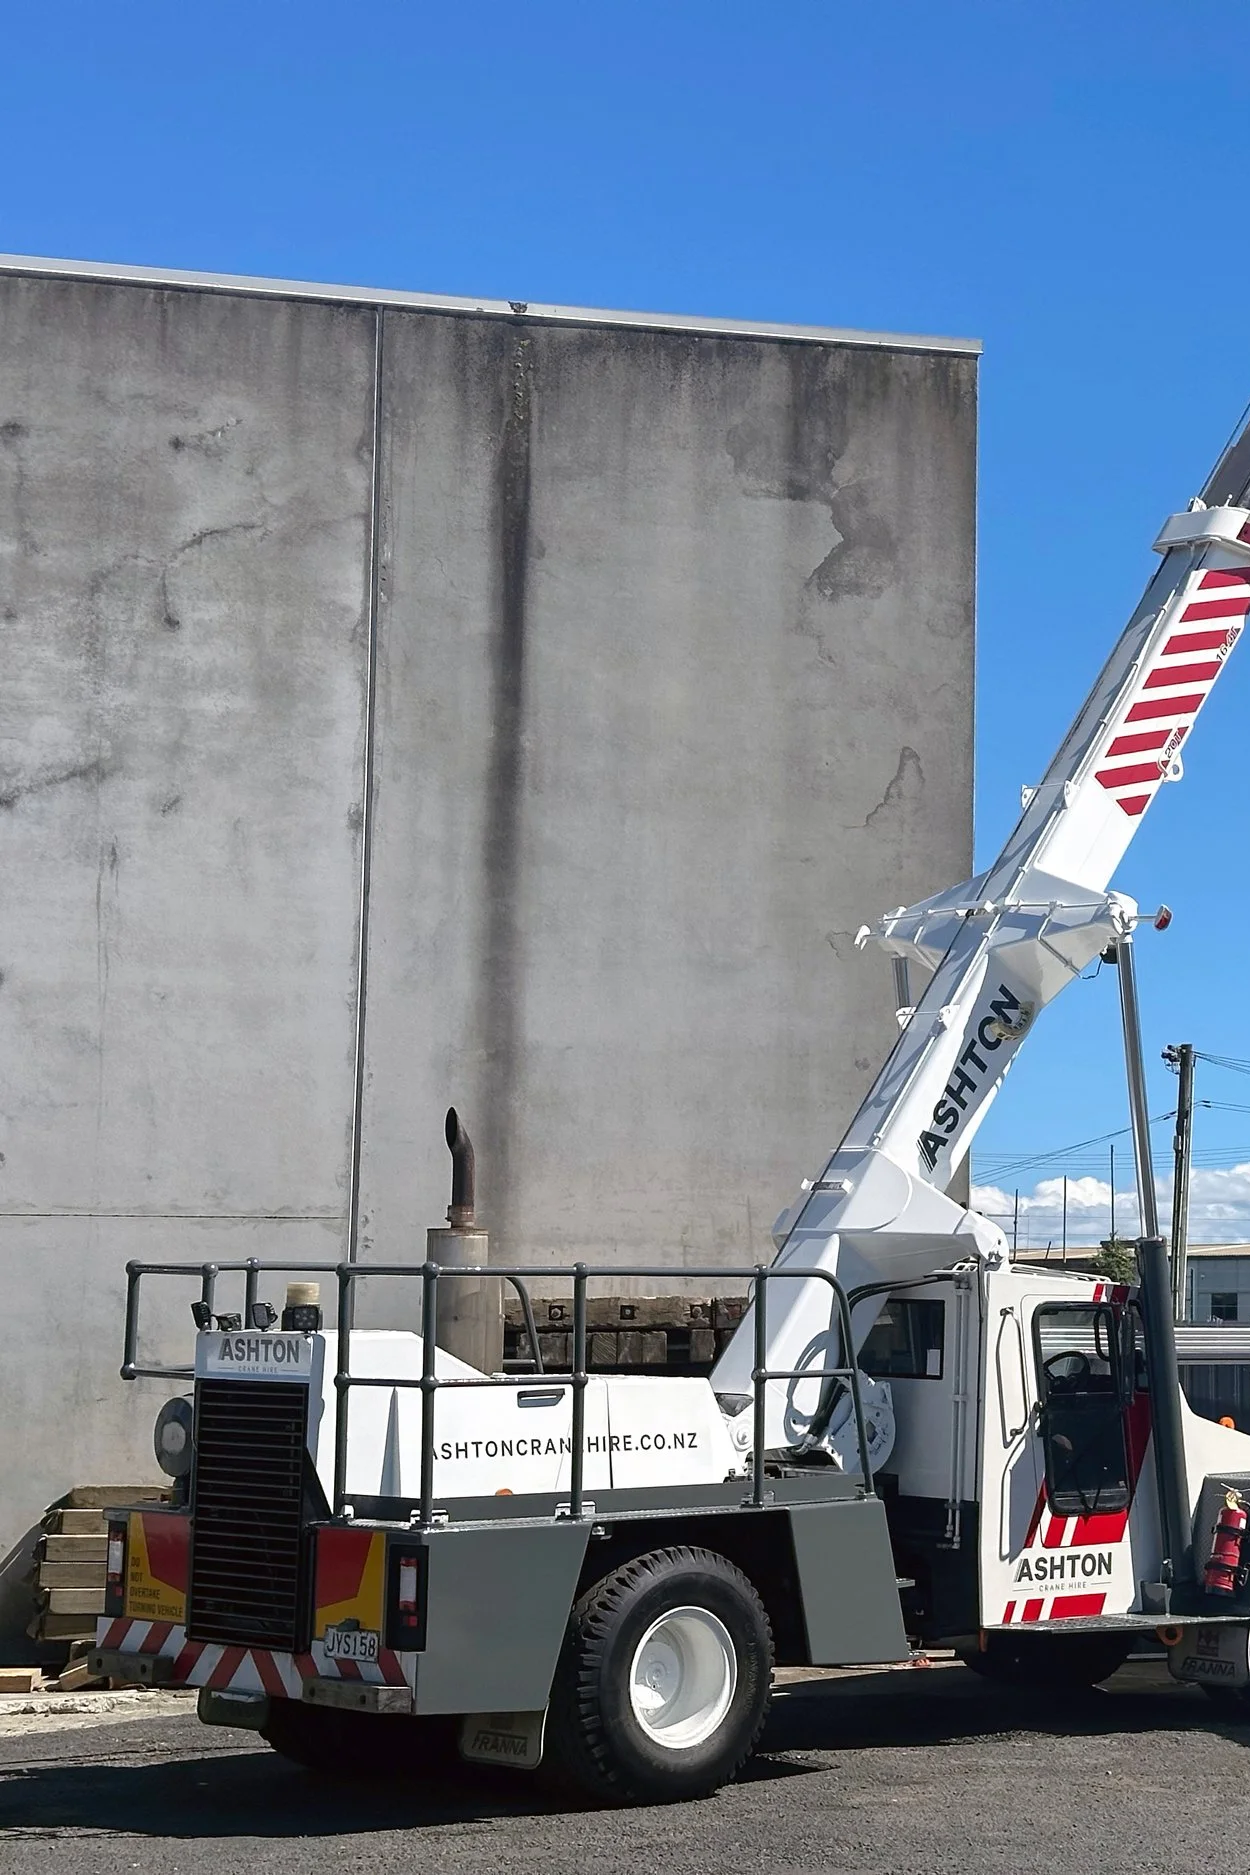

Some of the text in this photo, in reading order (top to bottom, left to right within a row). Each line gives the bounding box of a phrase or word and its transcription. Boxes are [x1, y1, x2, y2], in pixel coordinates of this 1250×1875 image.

[916, 984, 1021, 1174] ASHTON
[218, 1338, 300, 1363] ASHTON
[262, 1366, 278, 1374] HIRE
[431, 1432, 698, 1460] SHTONCRANHIRE.CO.NZ
[130, 1571, 143, 1582] NOT
[1014, 1552, 1112, 1582] ASHTON
[129, 1586, 160, 1600] OVERTAKE
[1038, 1581, 1087, 1592] CRANE HIRE
[326, 1631, 376, 1657] JYS158
